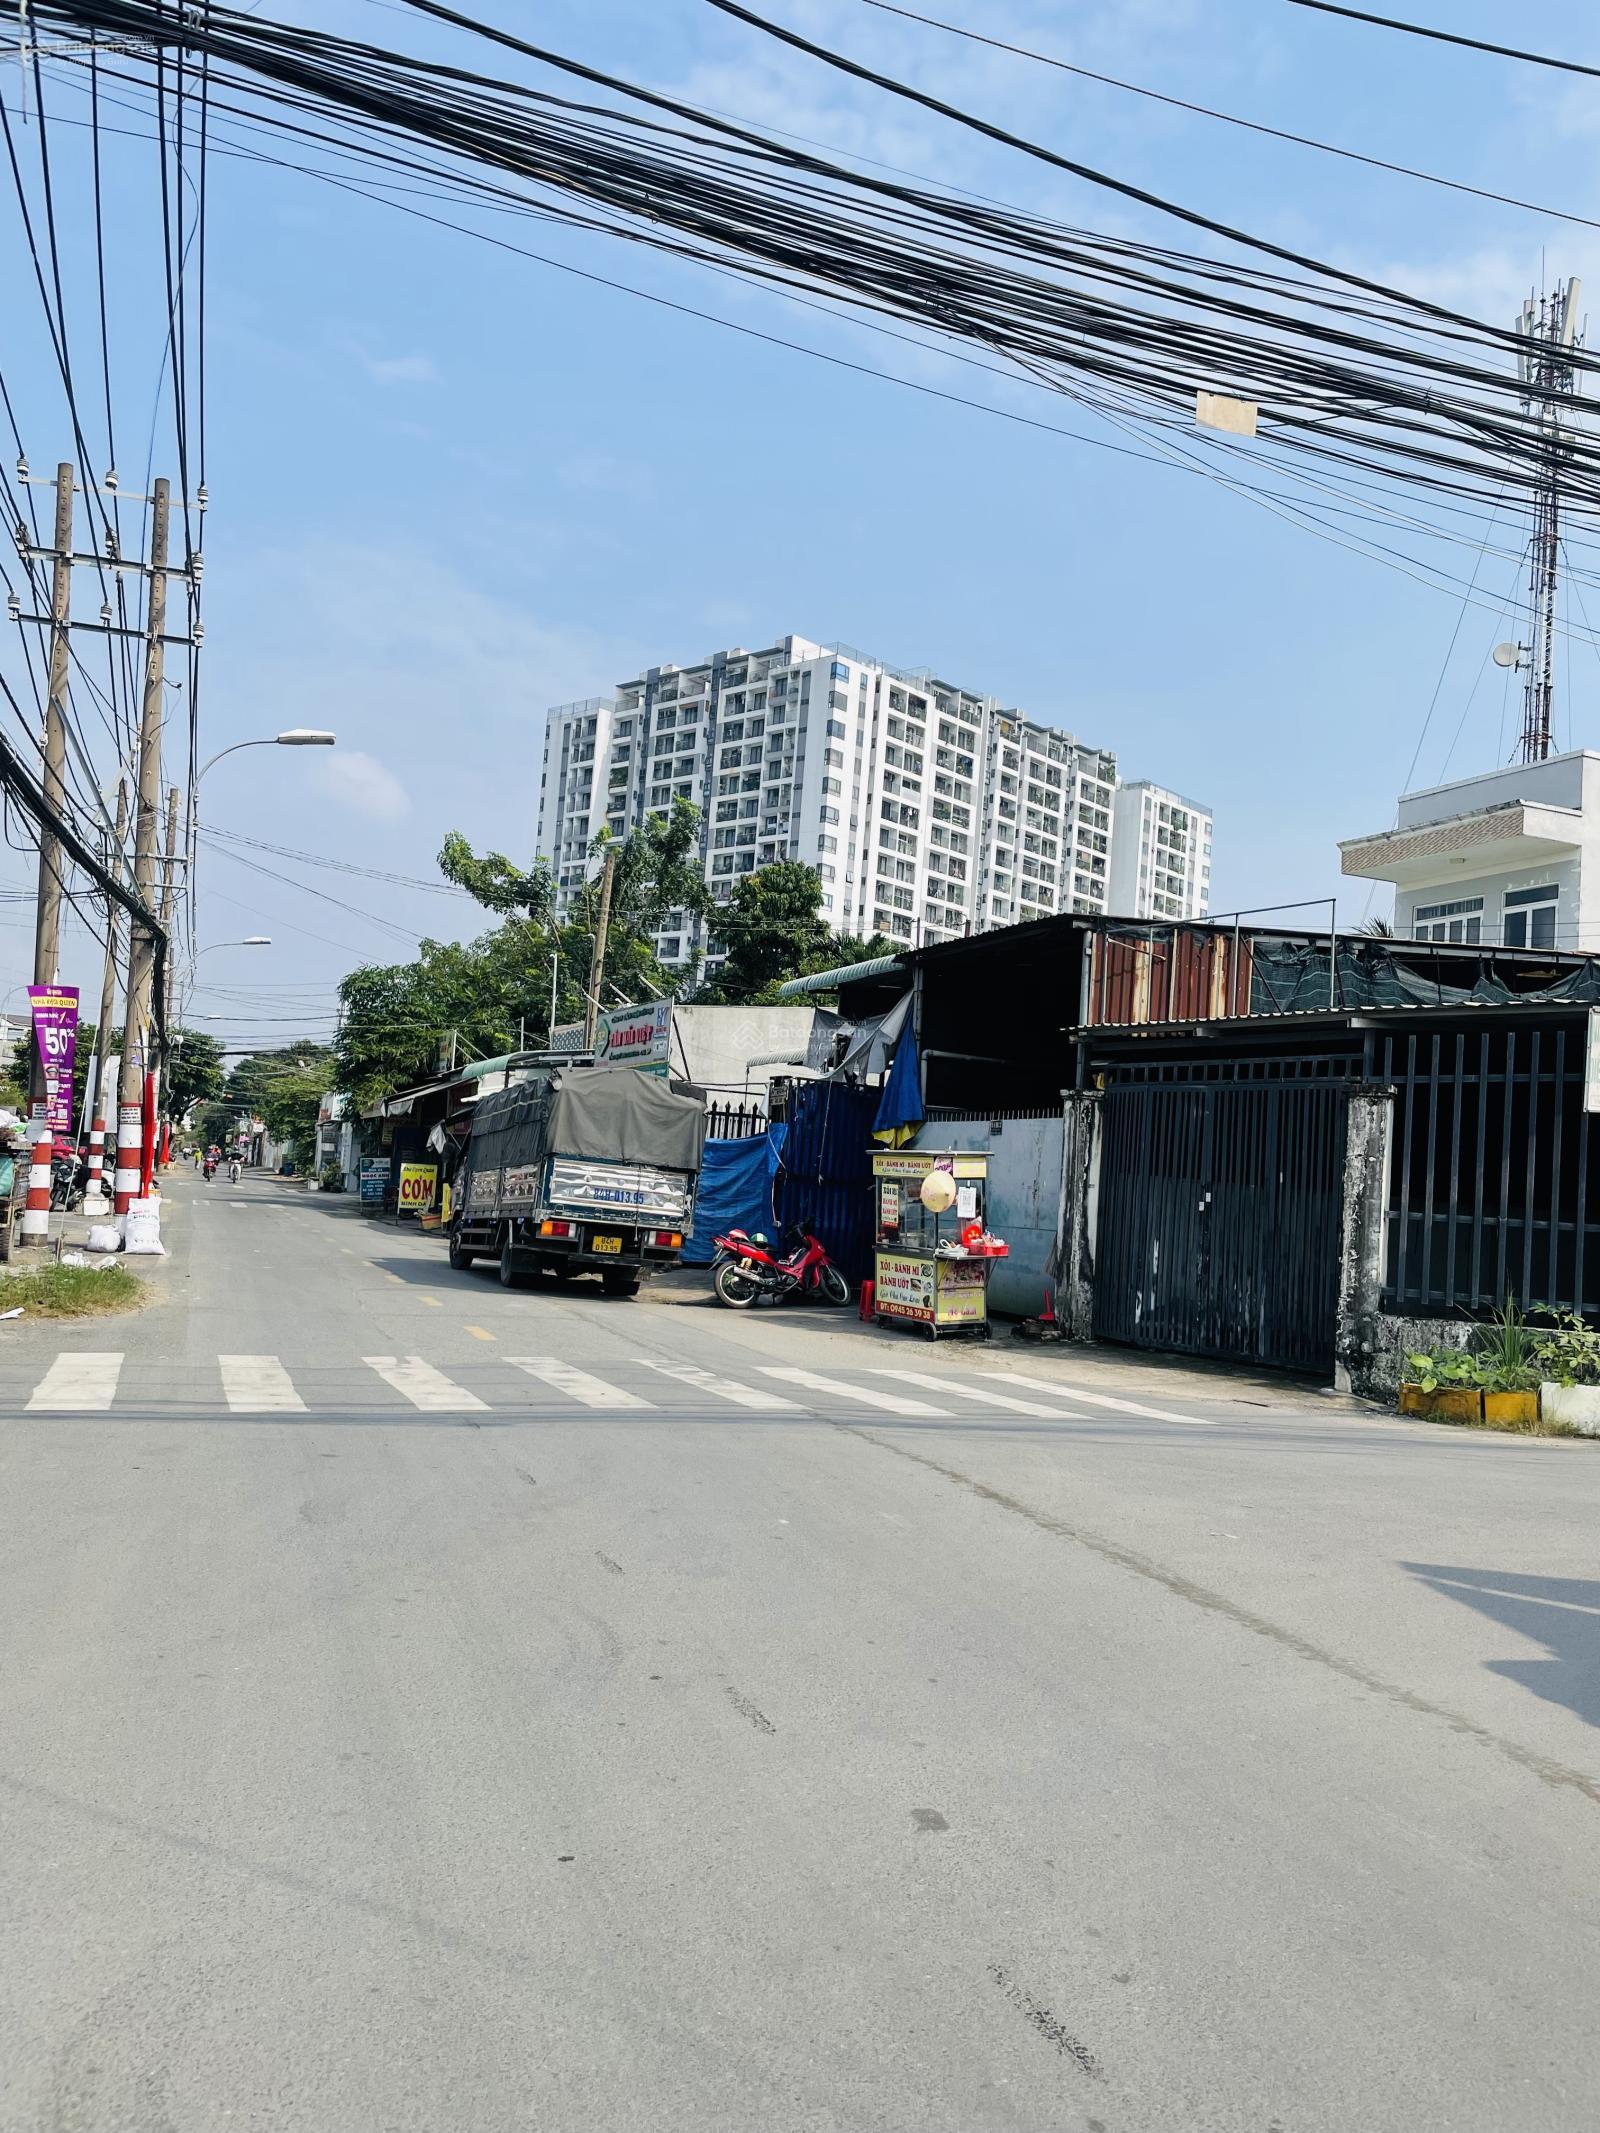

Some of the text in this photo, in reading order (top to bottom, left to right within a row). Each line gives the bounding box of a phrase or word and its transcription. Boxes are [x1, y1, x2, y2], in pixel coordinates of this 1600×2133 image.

[401, 1175, 434, 1200] CƠM
[593, 1187, 645, 1205] 84H-013.95
[601, 1237, 615, 1245] 84H
[880, 1259, 920, 1276] XÔI BÁNH MÌ
[880, 1274, 897, 1287] BÁNH
[890, 1303, 905, 1315] 0945
[905, 1307, 913, 1316] 26
